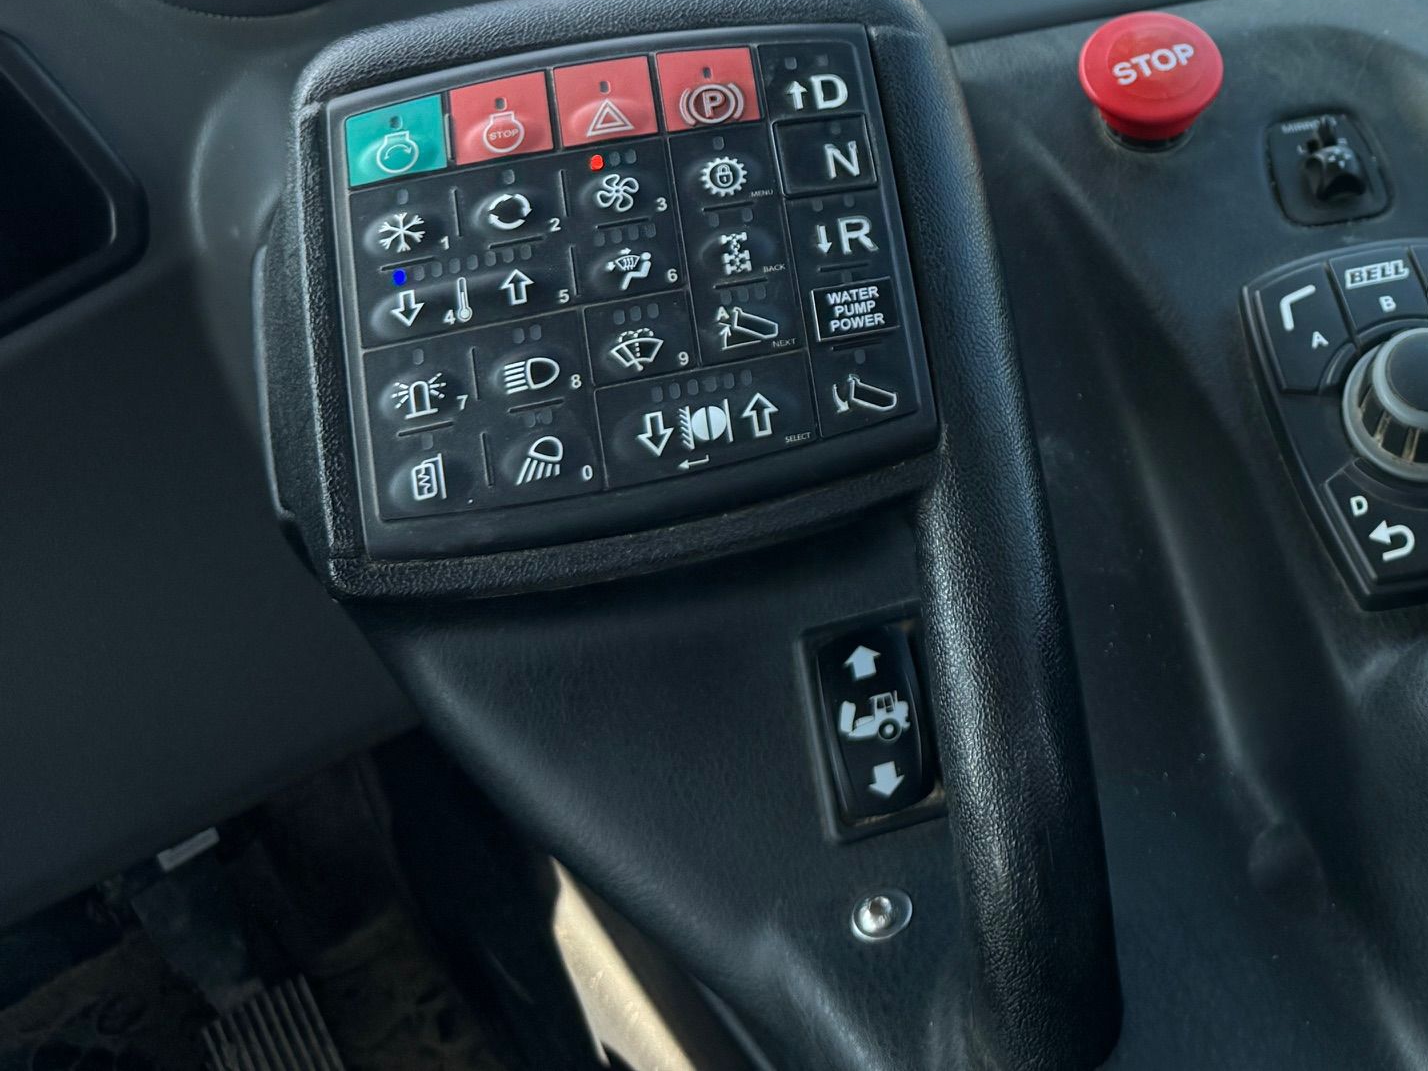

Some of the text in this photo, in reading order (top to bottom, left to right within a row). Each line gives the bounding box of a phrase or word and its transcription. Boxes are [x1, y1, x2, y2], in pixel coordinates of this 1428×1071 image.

[1112, 43, 1195, 85] STOP
[810, 74, 849, 110] D
[702, 91, 726, 118] P
[489, 128, 519, 141] STOP
[824, 140, 861, 179] N
[750, 189, 774, 198] MENU
[656, 197, 668, 213] 3
[549, 217, 561, 232] 2
[440, 236, 450, 250] 1
[837, 215, 879, 255] R
[666, 269, 678, 283] 6
[763, 263, 786, 273] BACK
[1344, 259, 1410, 290] BELL
[558, 289, 570, 304] 5
[826, 285, 880, 305] WATER
[834, 300, 876, 318] PUMP
[1379, 295, 1397, 313] B
[443, 310, 456, 325] 4
[716, 306, 730, 321] A
[830, 313, 885, 333] POWER
[772, 338, 797, 348] NEXT
[1311, 331, 1329, 349] A
[678, 351, 690, 366] 9
[570, 374, 582, 390] 8
[457, 394, 469, 410] 7
[784, 432, 811, 444] SELECT
[581, 464, 594, 481] 0
[1350, 495, 1368, 517] D
